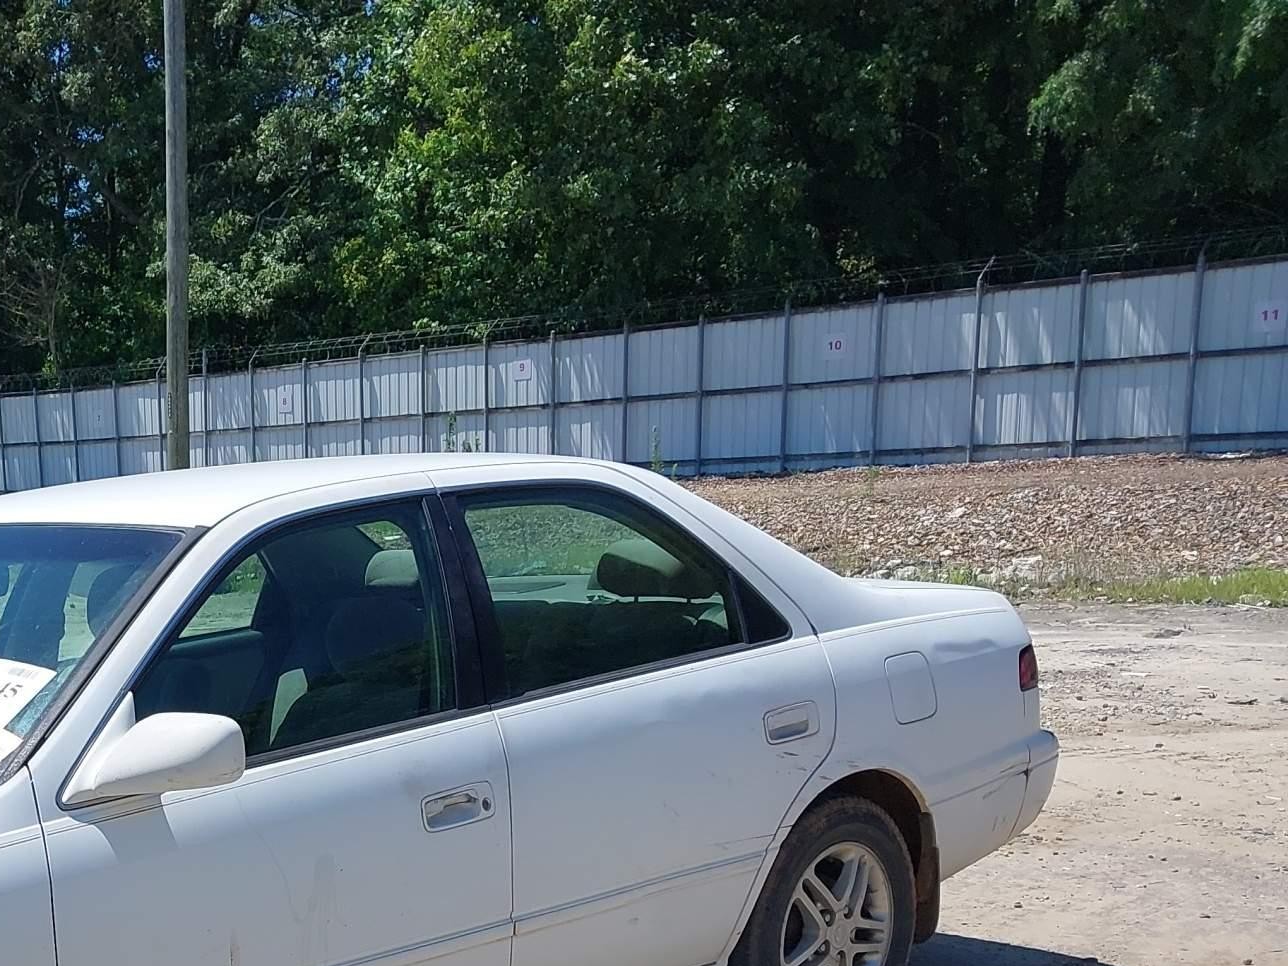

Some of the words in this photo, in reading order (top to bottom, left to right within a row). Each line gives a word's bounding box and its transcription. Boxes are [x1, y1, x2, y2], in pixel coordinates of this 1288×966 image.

[1262, 309, 1279, 321] 11
[828, 340, 842, 351] 10
[519, 362, 525, 372] 9
